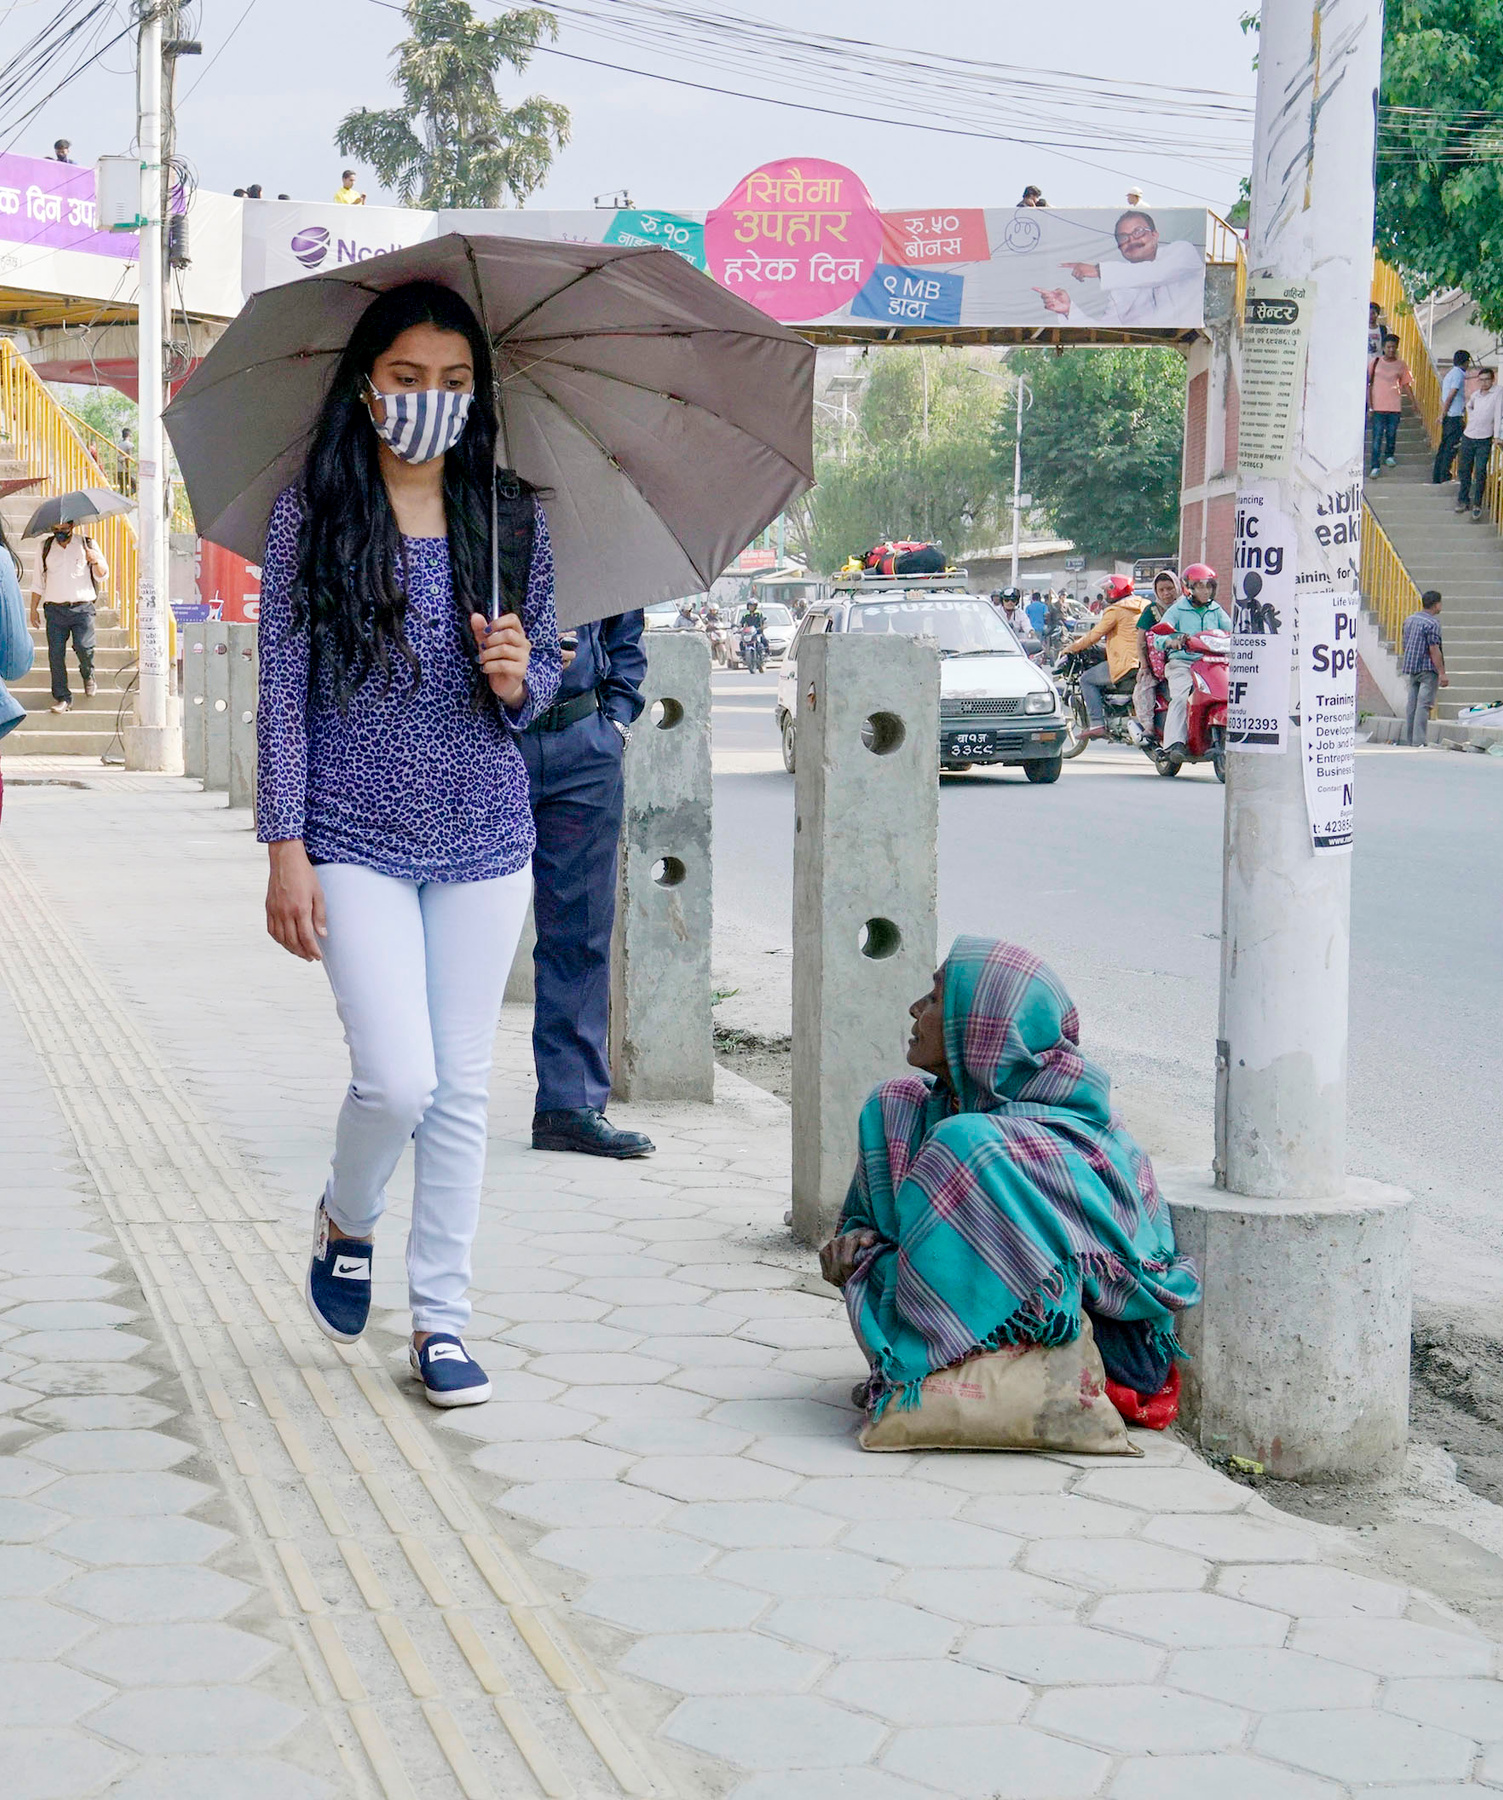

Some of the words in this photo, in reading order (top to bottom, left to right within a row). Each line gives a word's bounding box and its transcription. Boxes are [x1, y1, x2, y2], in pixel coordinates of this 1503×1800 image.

[26, 185, 63, 223] दिन
[67, 198, 99, 232] उप
[733, 210, 852, 247] उपहार
[904, 236, 962, 258] बोनस
[723, 248, 799, 285] हरेक
[809, 252, 863, 285] दिन
[903, 277, 940, 300] MB
[888, 296, 930, 319] डाटा
[1234, 510, 1259, 538] lic
[1337, 568, 1350, 579] for
[883, 601, 979, 614] SUZUKI
[1333, 597, 1348, 607] Life
[1316, 740, 1335, 750] Job
